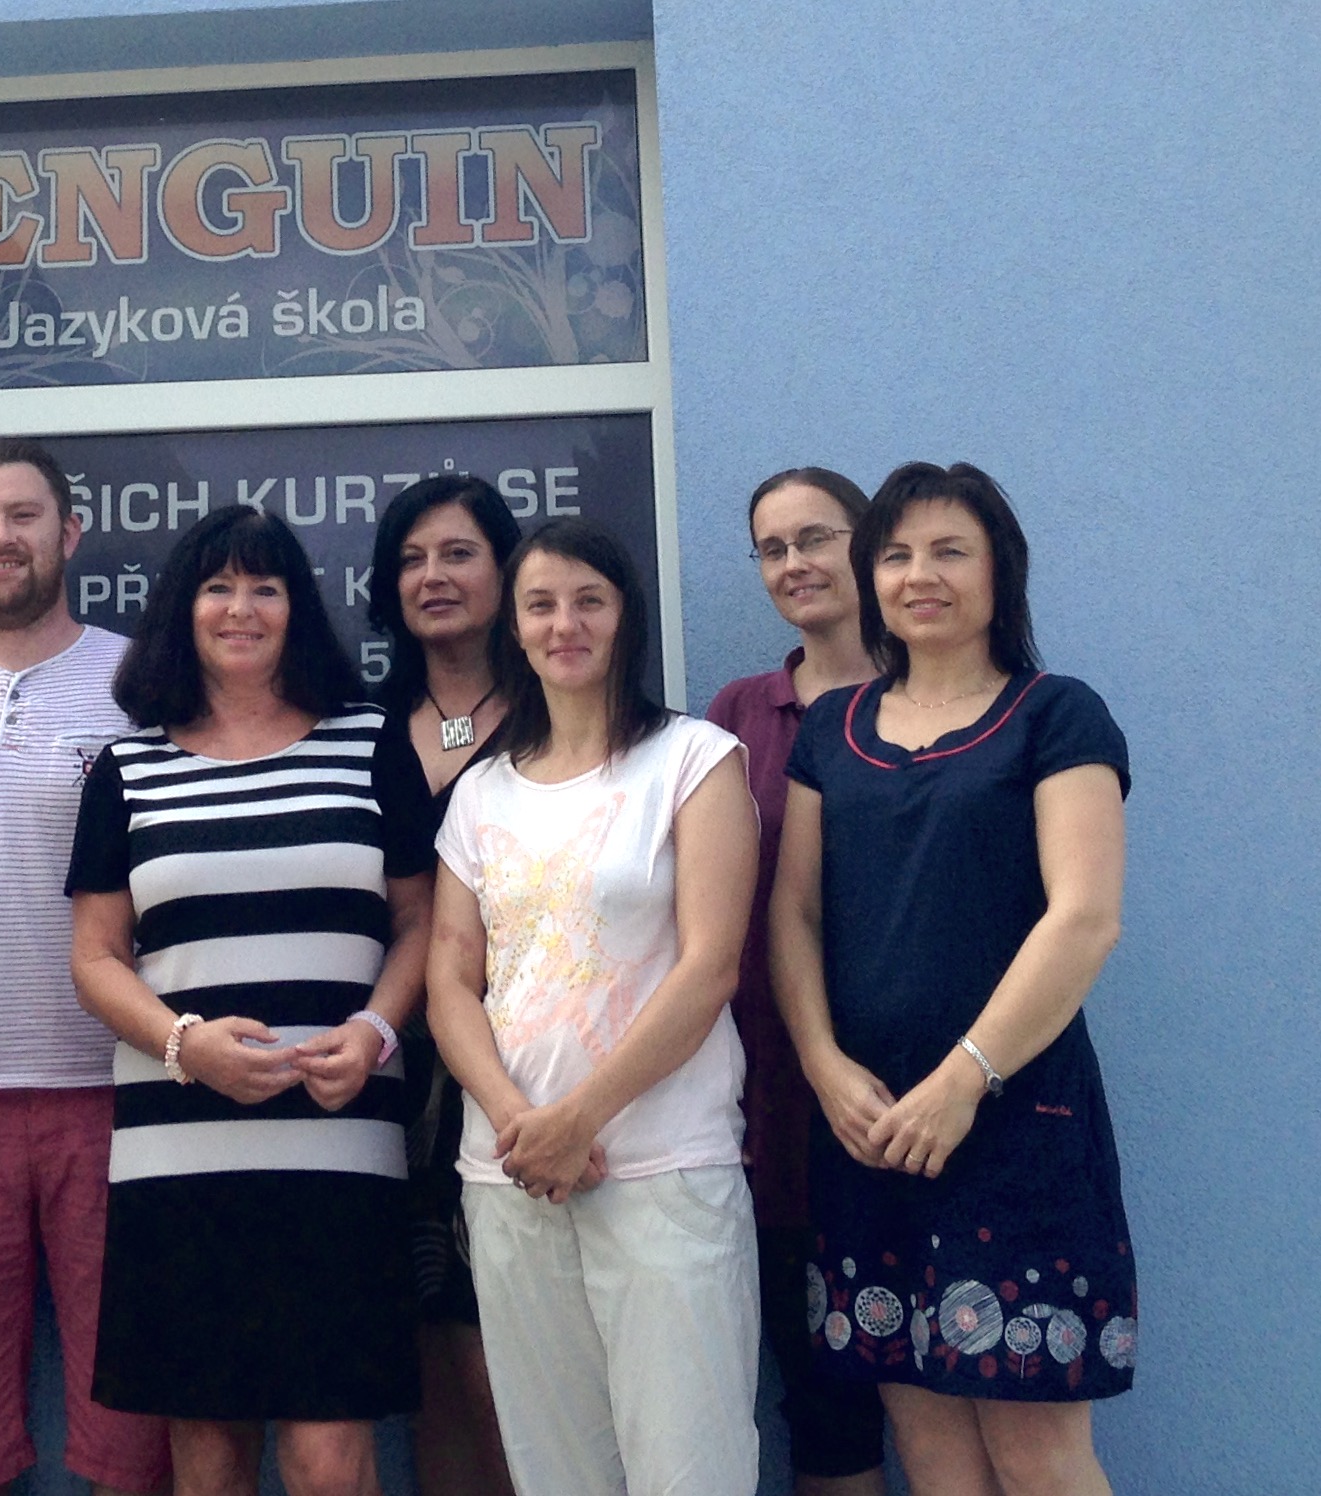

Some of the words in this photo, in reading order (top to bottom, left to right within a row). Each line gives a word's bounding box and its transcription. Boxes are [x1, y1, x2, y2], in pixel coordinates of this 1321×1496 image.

[272, 286, 427, 339] škola
[64, 473, 209, 533] ŠICH
[497, 467, 580, 519] SE
